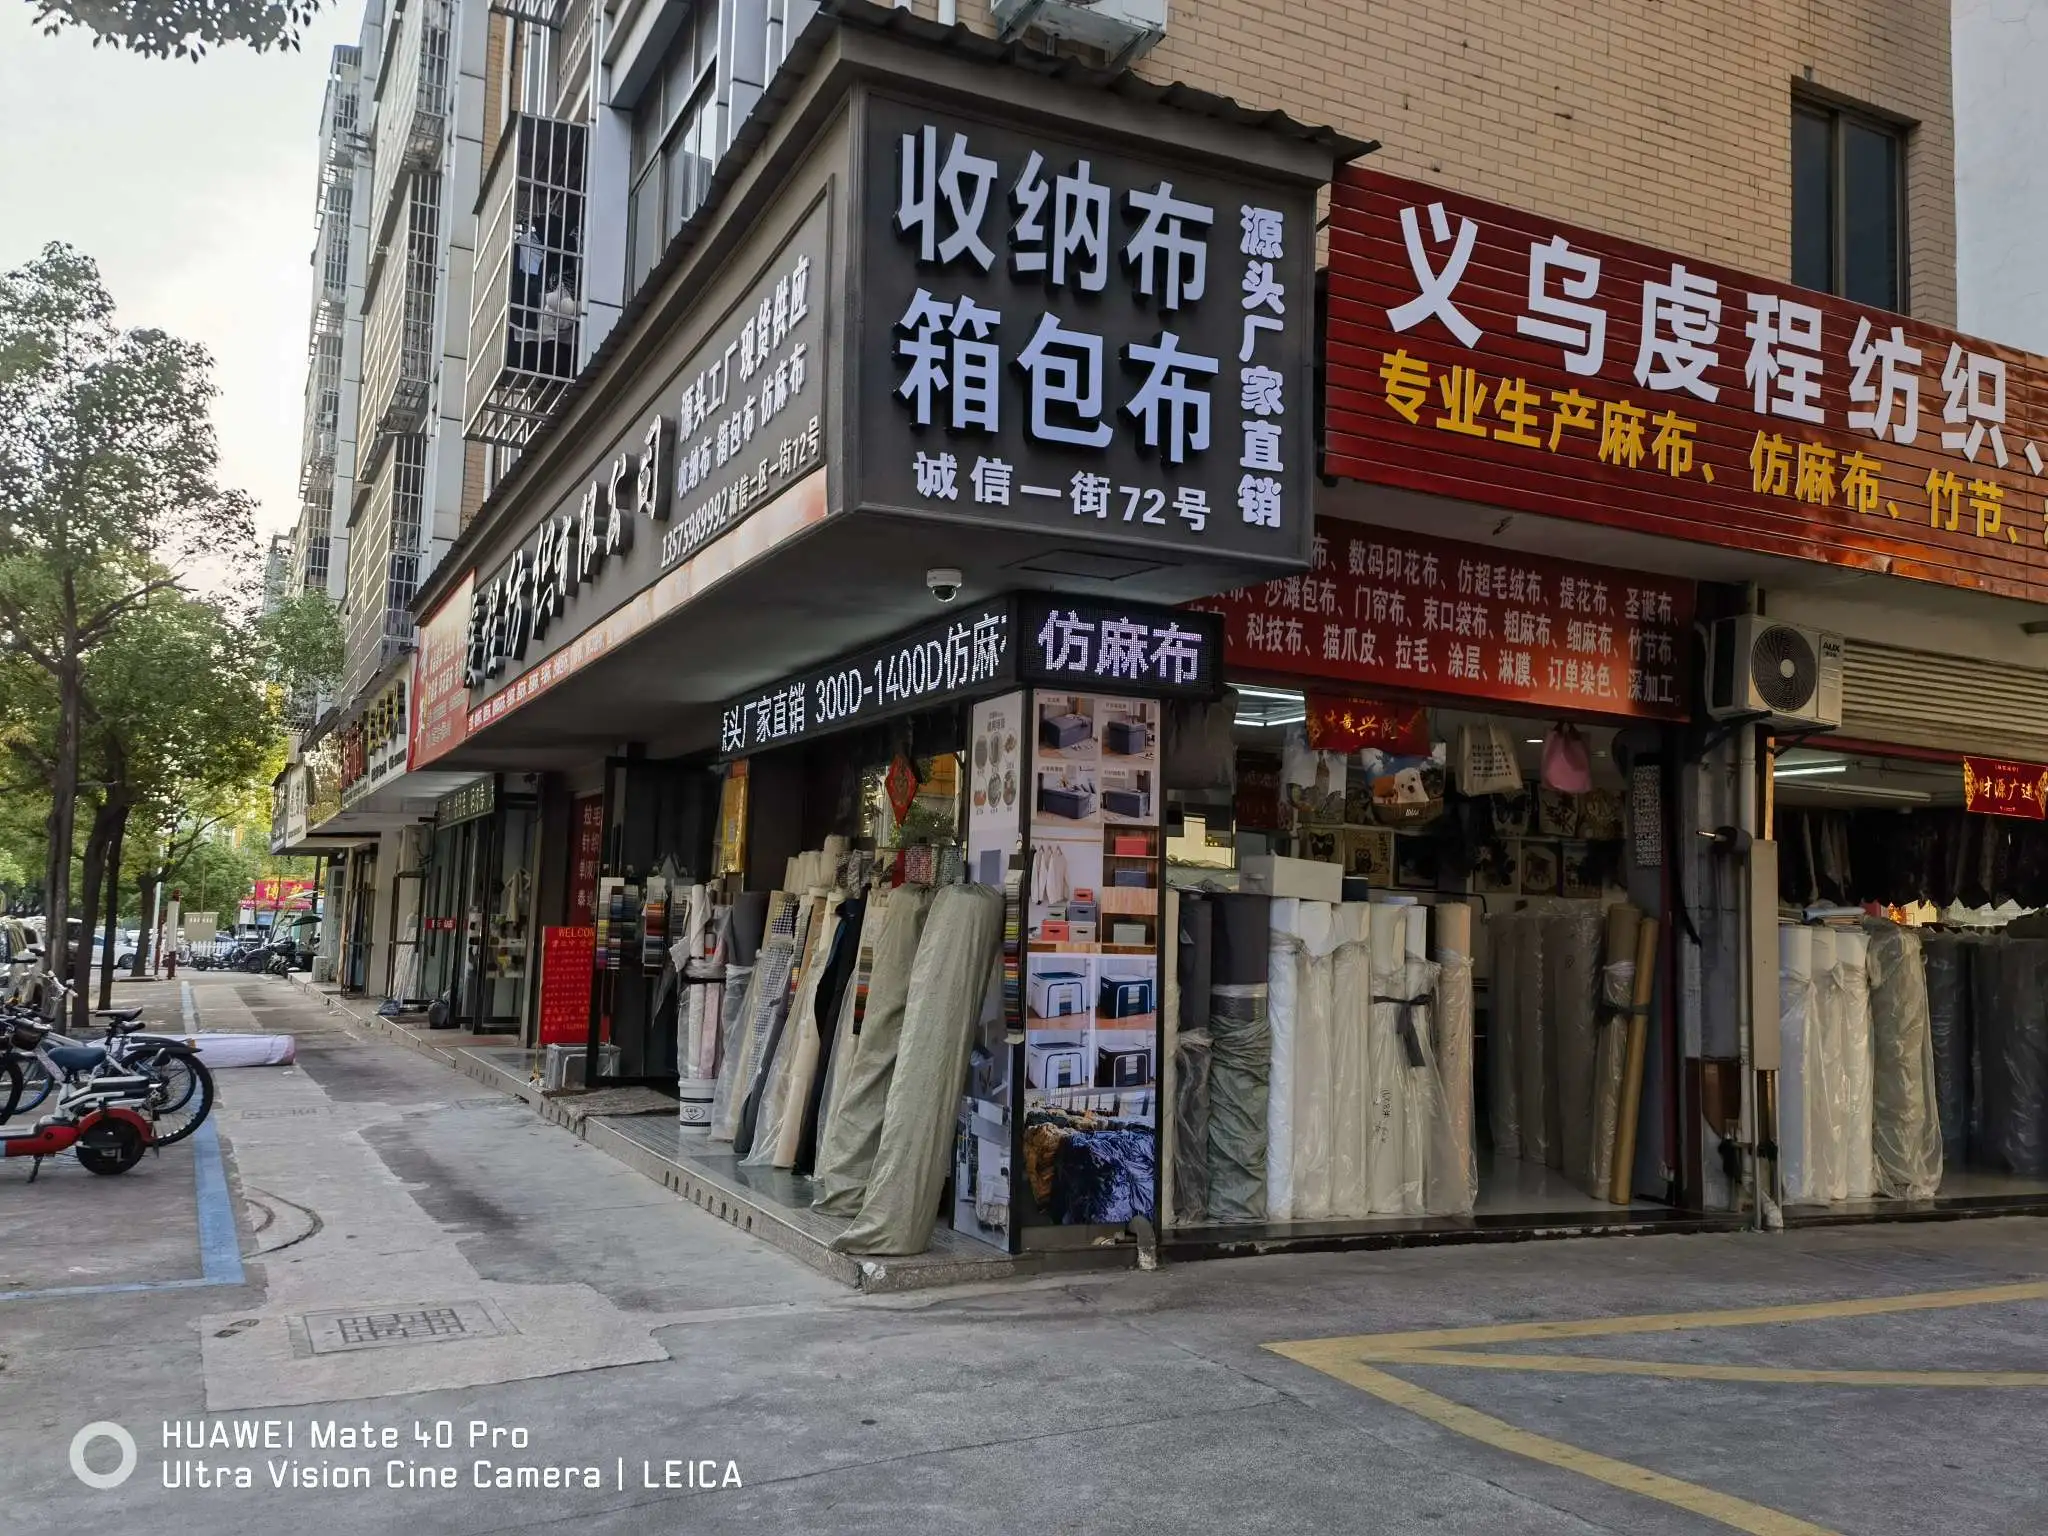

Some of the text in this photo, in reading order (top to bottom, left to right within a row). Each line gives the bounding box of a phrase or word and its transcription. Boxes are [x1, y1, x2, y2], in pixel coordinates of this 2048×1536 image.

[898, 125, 1214, 310] 收纳布
[900, 287, 1219, 464] 箱包布
[1237, 205, 1285, 528] 源头厂家直销
[913, 451, 1211, 532] 诚信一街72号
[1038, 609, 1202, 683] 仿麻布
